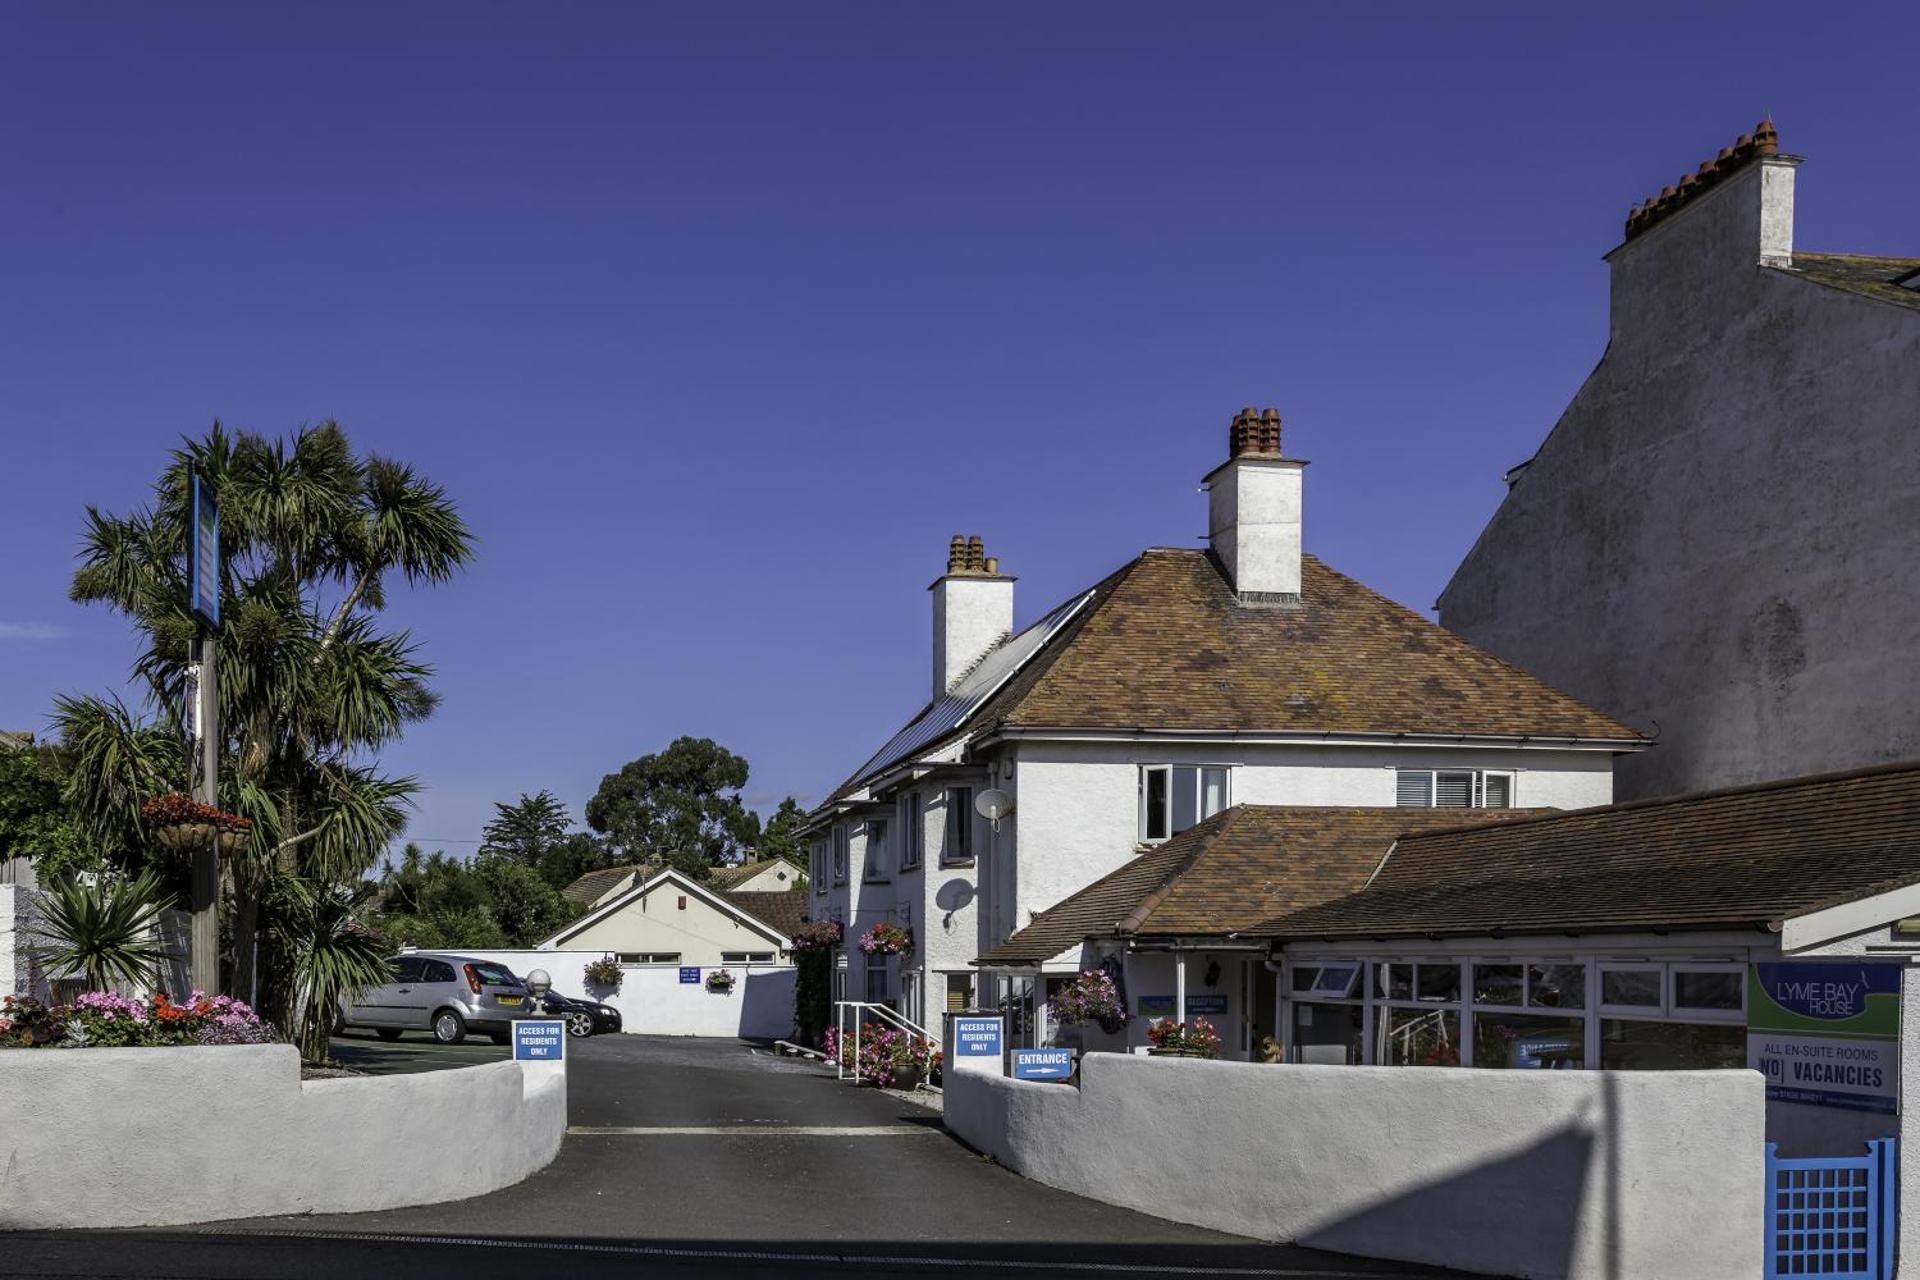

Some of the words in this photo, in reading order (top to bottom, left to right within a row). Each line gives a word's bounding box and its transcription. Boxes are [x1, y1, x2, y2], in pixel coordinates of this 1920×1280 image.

[1777, 983, 1820, 1001] LYME
[1825, 983, 1859, 1001] BAY
[1809, 1000, 1853, 1015] HOUSE
[518, 1027, 545, 1035] ACCESS
[546, 1027, 560, 1035] FOR
[960, 1023, 985, 1031] ACCESS
[986, 1023, 998, 1031] FOR
[521, 1037, 557, 1046] RESIDENTS
[962, 1033, 997, 1041] RESIDENTS
[530, 1047, 548, 1055] ONLY
[971, 1043, 988, 1051] ONLY
[1765, 1043, 1782, 1054] ALL
[1785, 1045, 1834, 1058] EN-SUITE
[1837, 1047, 1879, 1062] ROOMS
[1019, 1053, 1068, 1065] ENTRANCE
[1760, 1057, 1779, 1076] NO
[1794, 1061, 1882, 1088] VACANCIES
